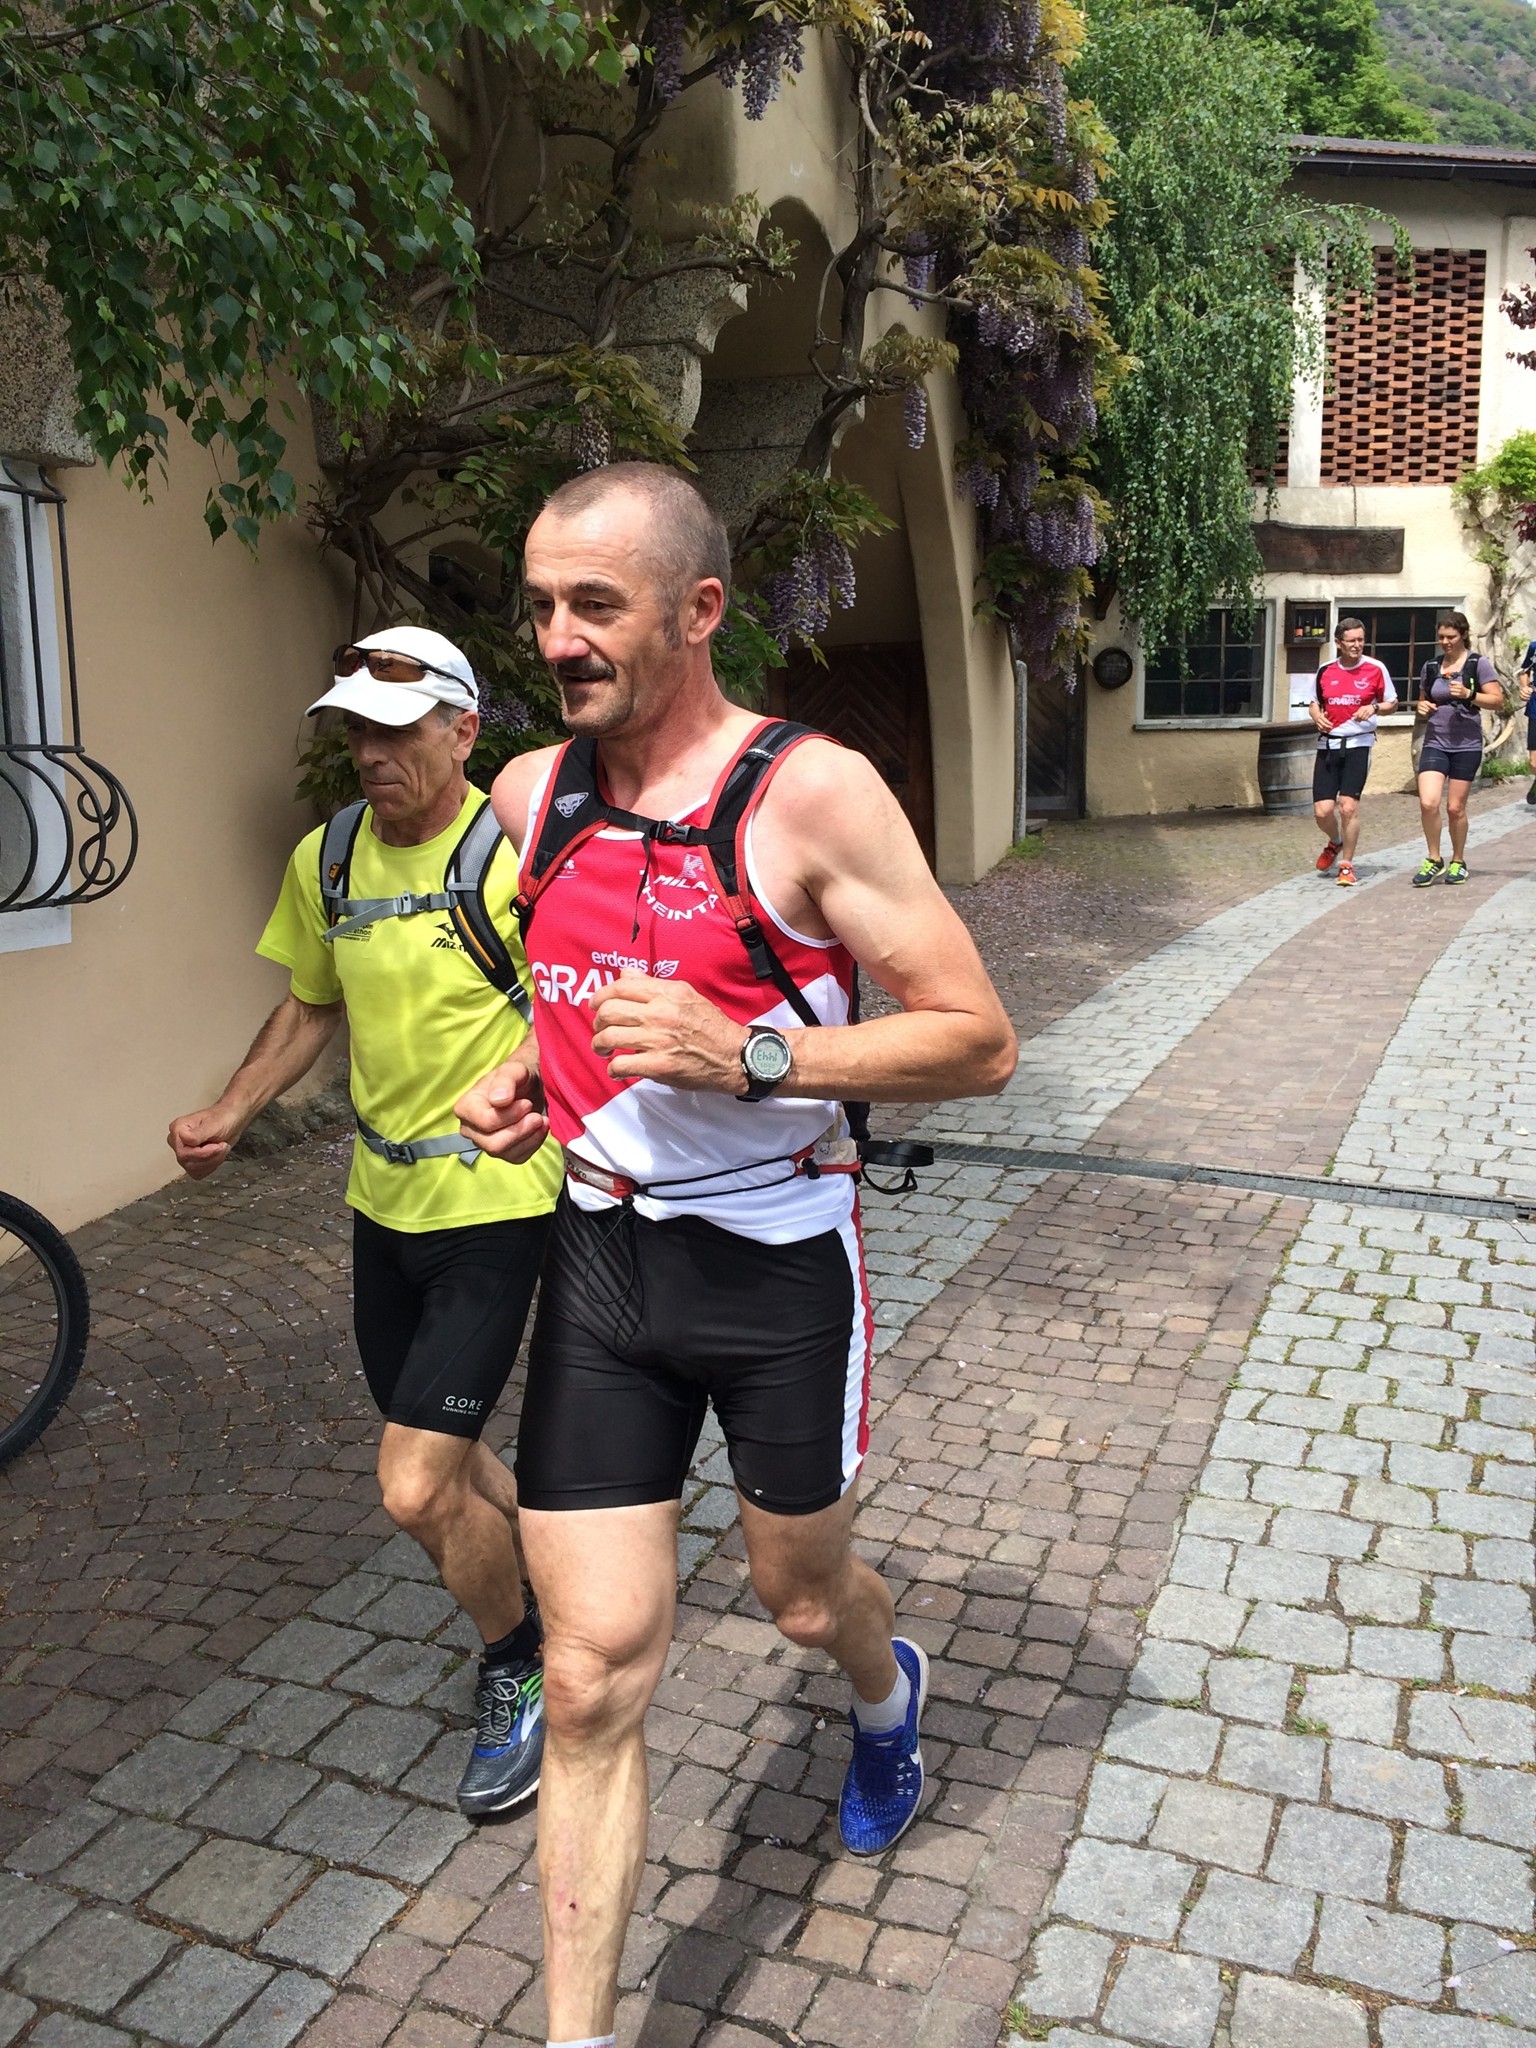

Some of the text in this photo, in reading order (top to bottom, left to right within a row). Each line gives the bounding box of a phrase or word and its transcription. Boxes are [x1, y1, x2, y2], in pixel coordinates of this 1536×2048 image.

[1328, 697, 1361, 706] GRAVAG
[591, 951, 648, 974] erdgas
[445, 1395, 484, 1411] GORE
